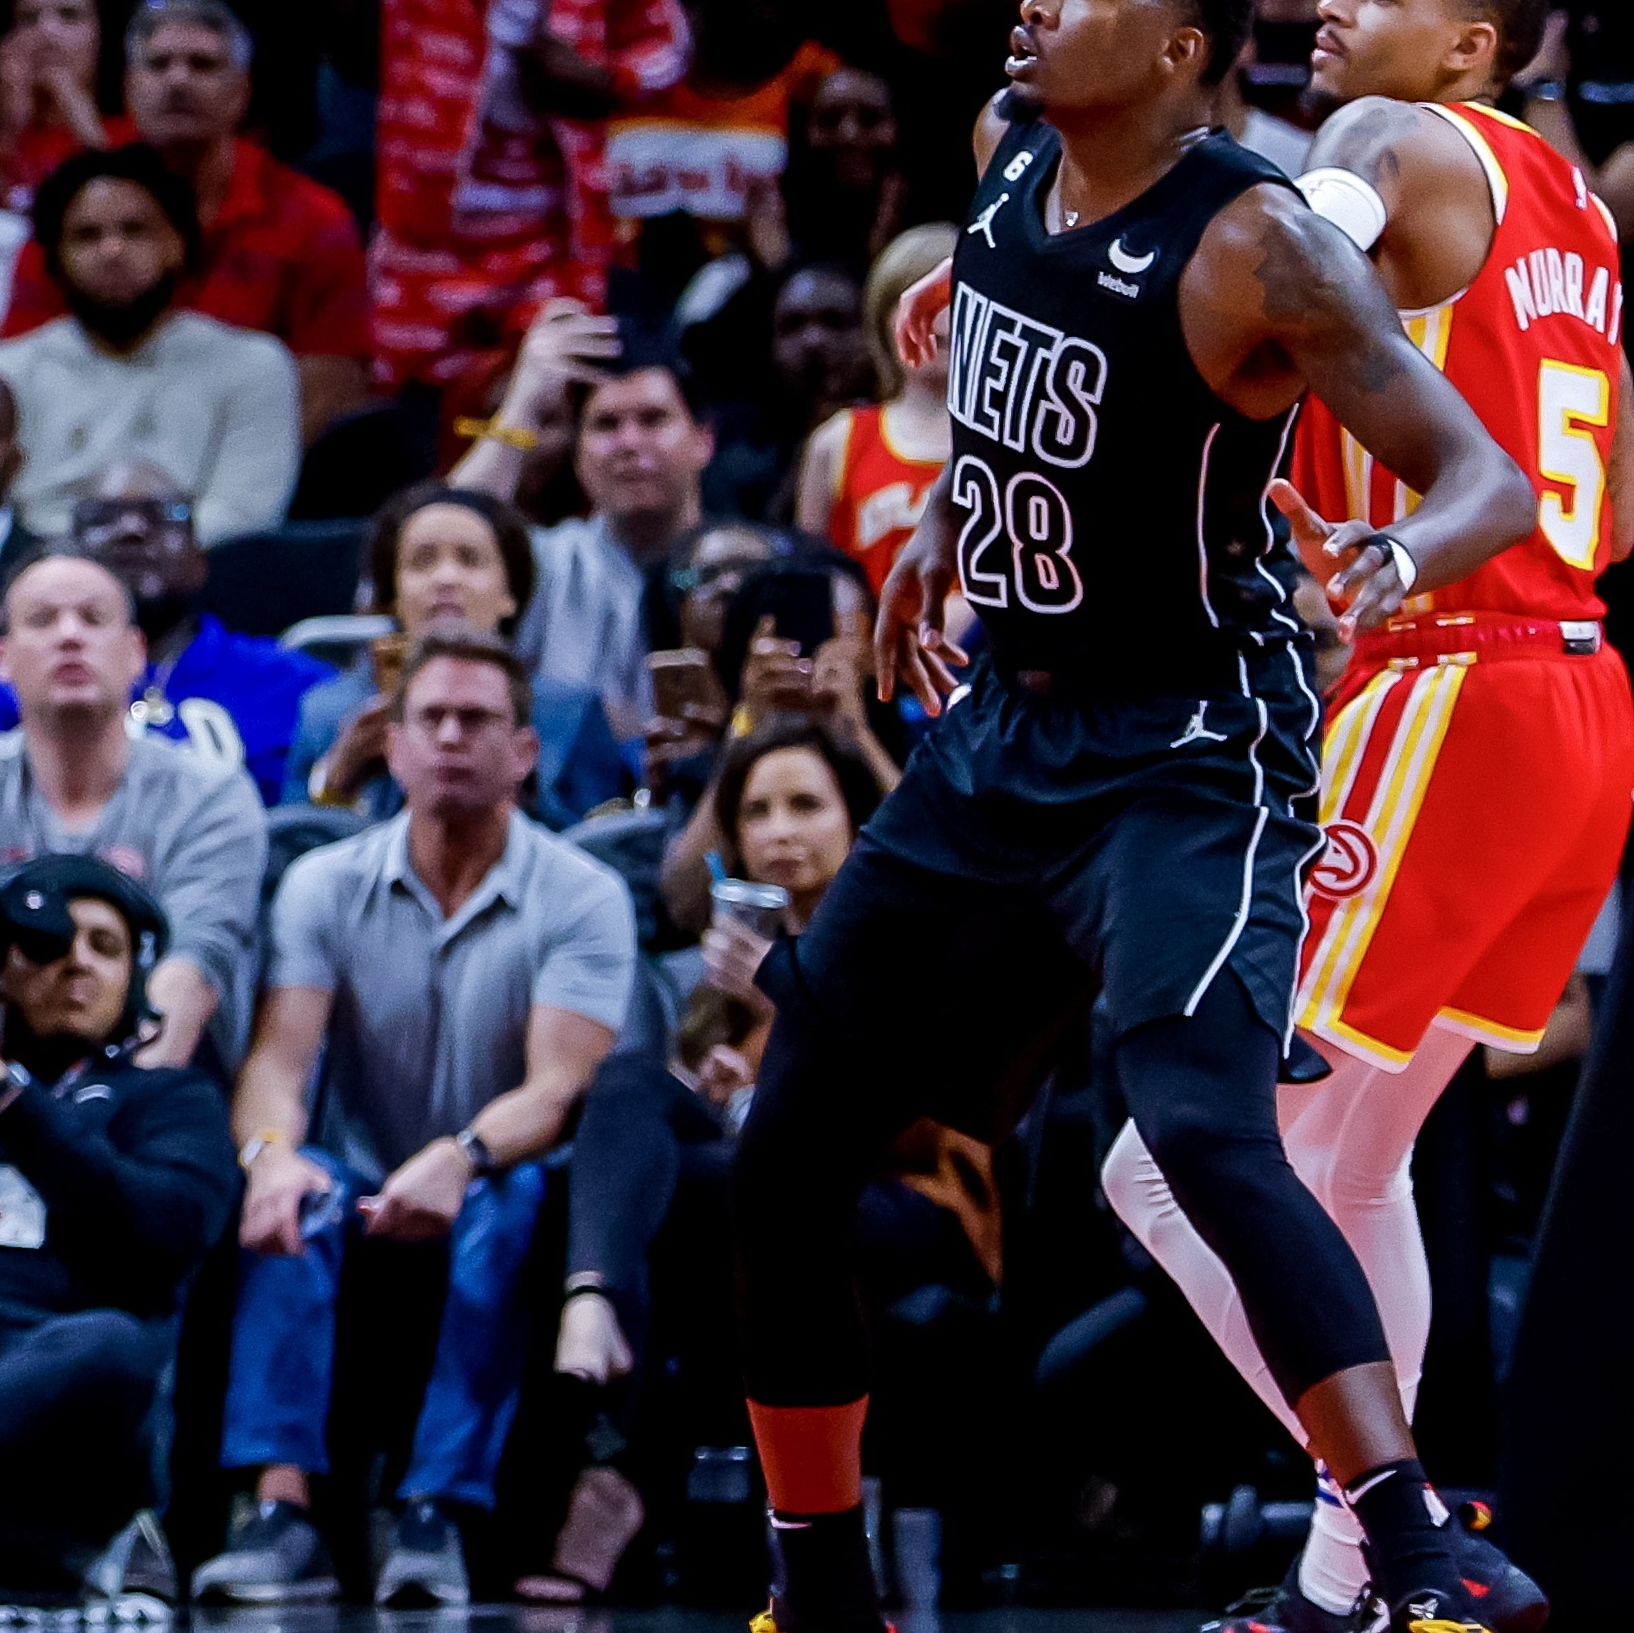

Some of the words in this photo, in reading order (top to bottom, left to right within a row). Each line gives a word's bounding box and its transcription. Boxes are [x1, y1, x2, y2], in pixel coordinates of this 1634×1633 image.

[1002, 150, 1033, 182] 6
[947, 280, 1108, 469] NETS
[951, 453, 1084, 615] 28
[1537, 356, 1610, 573] 5
